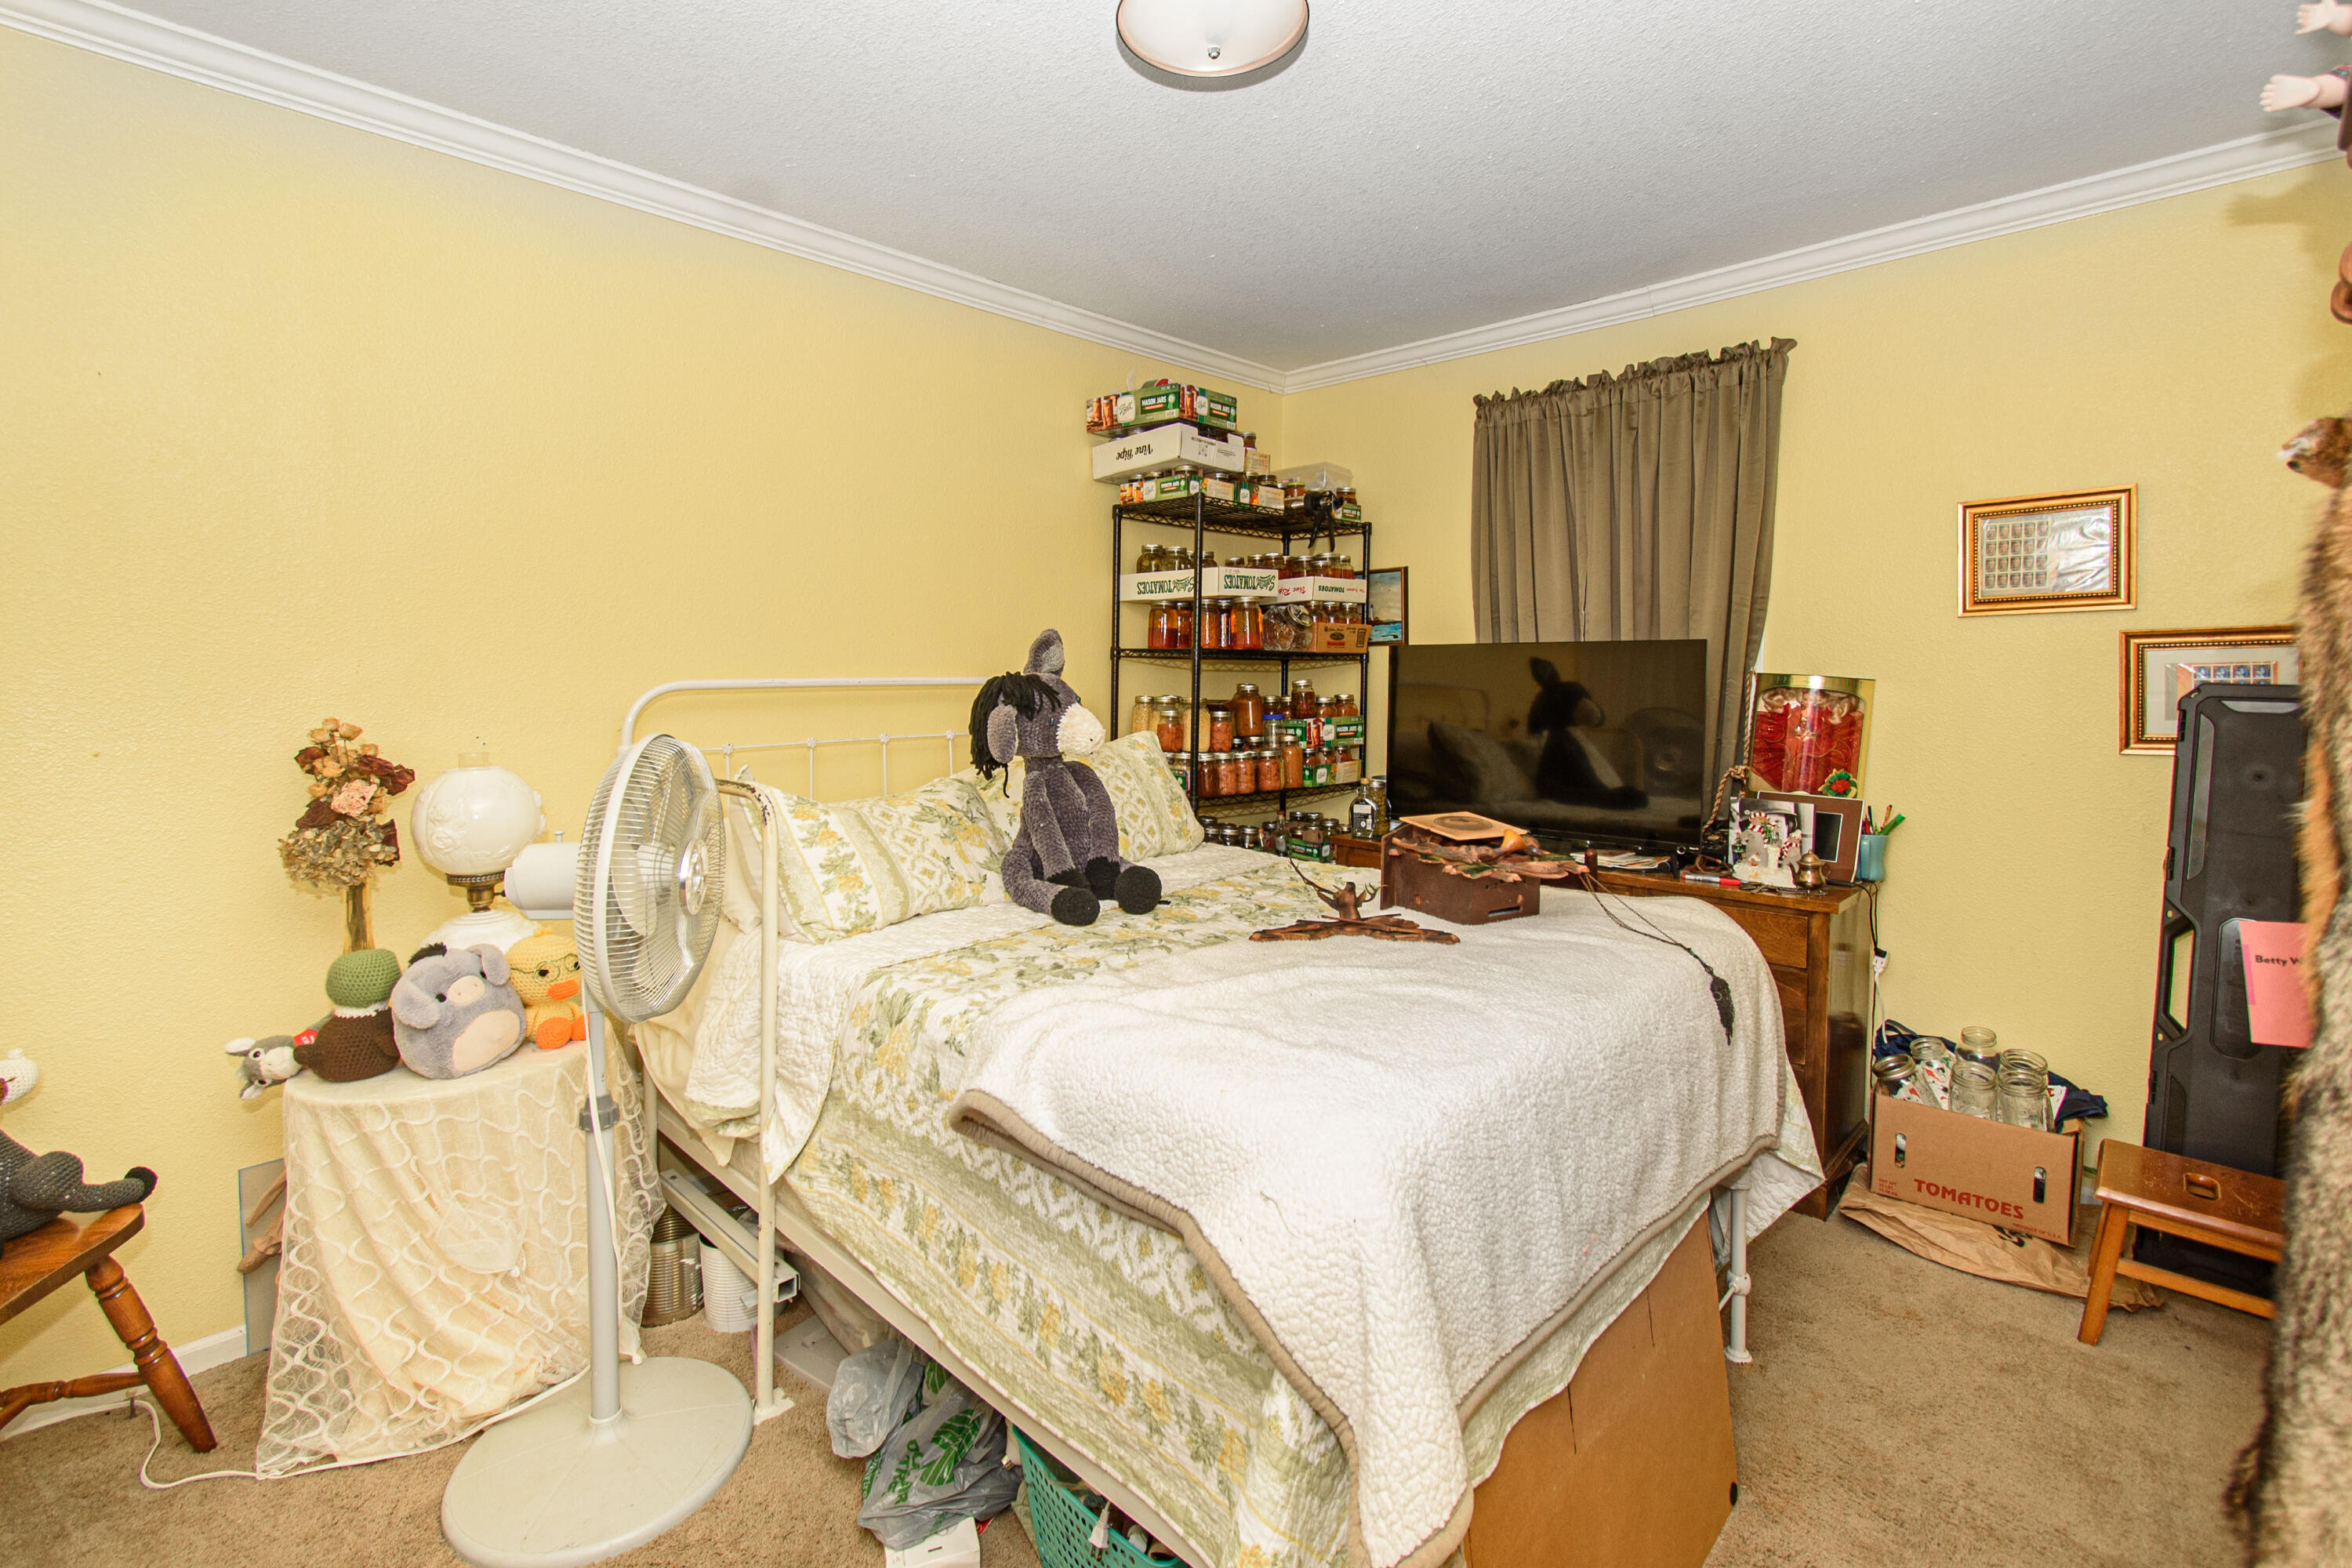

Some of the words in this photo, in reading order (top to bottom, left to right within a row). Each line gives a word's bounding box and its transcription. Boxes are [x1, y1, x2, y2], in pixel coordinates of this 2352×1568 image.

[1142, 397, 1156, 407] MASON
[1156, 395, 1167, 405] JARS
[1116, 448, 1134, 461] Ripe
[1134, 444, 1153, 456] Vine
[1137, 579, 1172, 594] TOMATOES
[1224, 574, 1256, 590] TOMATOES
[1318, 584, 1345, 593] TOMATOES
[2255, 954, 2288, 967] Betty
[1914, 1178, 2024, 1220] TOMATOES
